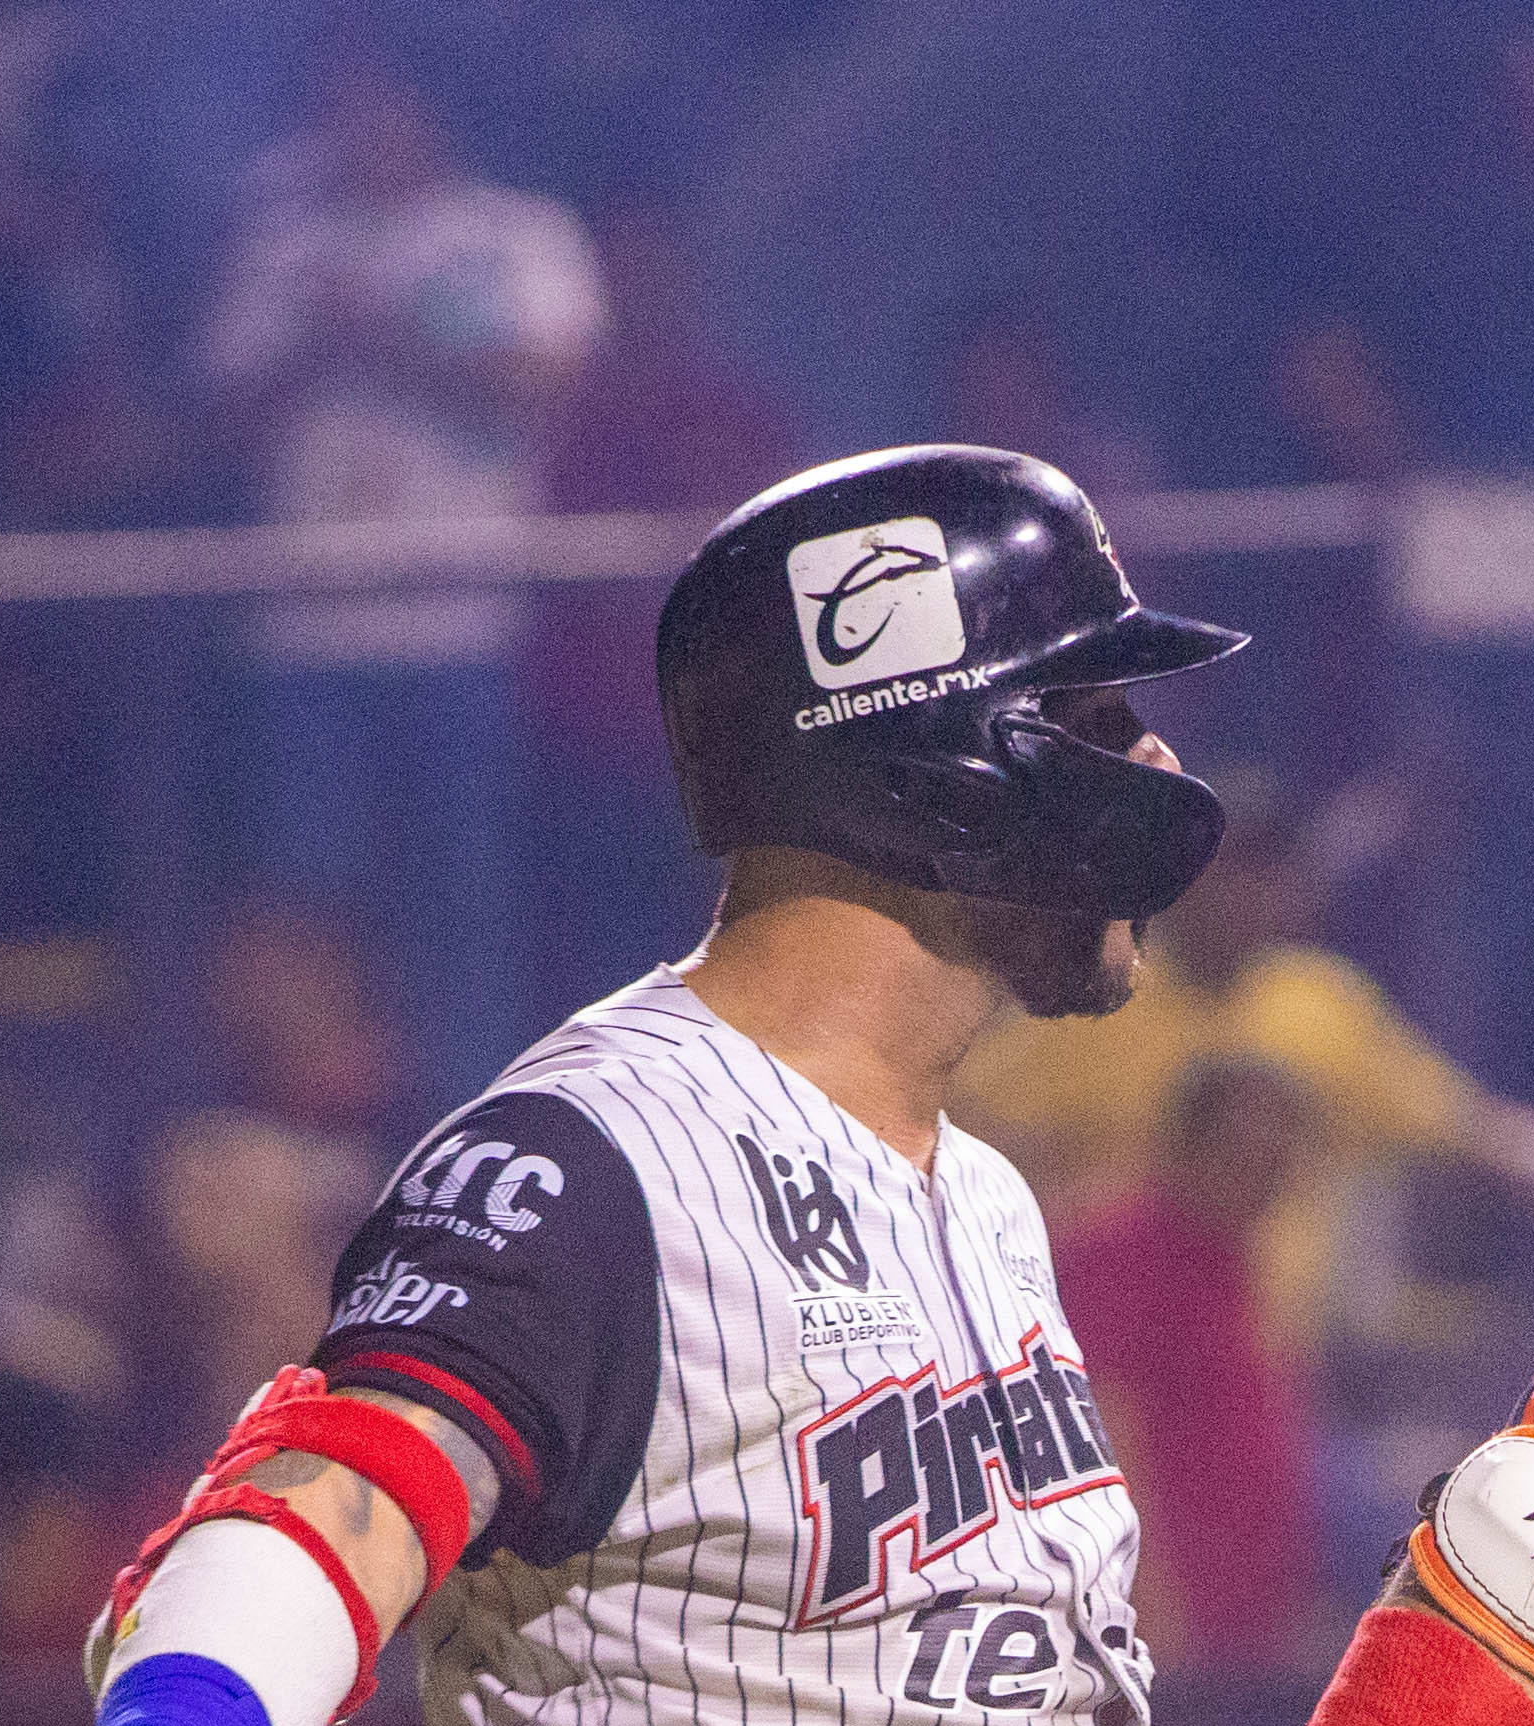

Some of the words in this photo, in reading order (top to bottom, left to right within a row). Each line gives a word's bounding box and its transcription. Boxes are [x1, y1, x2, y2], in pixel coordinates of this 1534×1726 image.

[794, 664, 992, 731] caliente.mx
[395, 1213, 508, 1252] TELEVISIÓN
[801, 1328, 844, 1348] CLUB
[848, 1323, 921, 1342] DEPORTIVO
